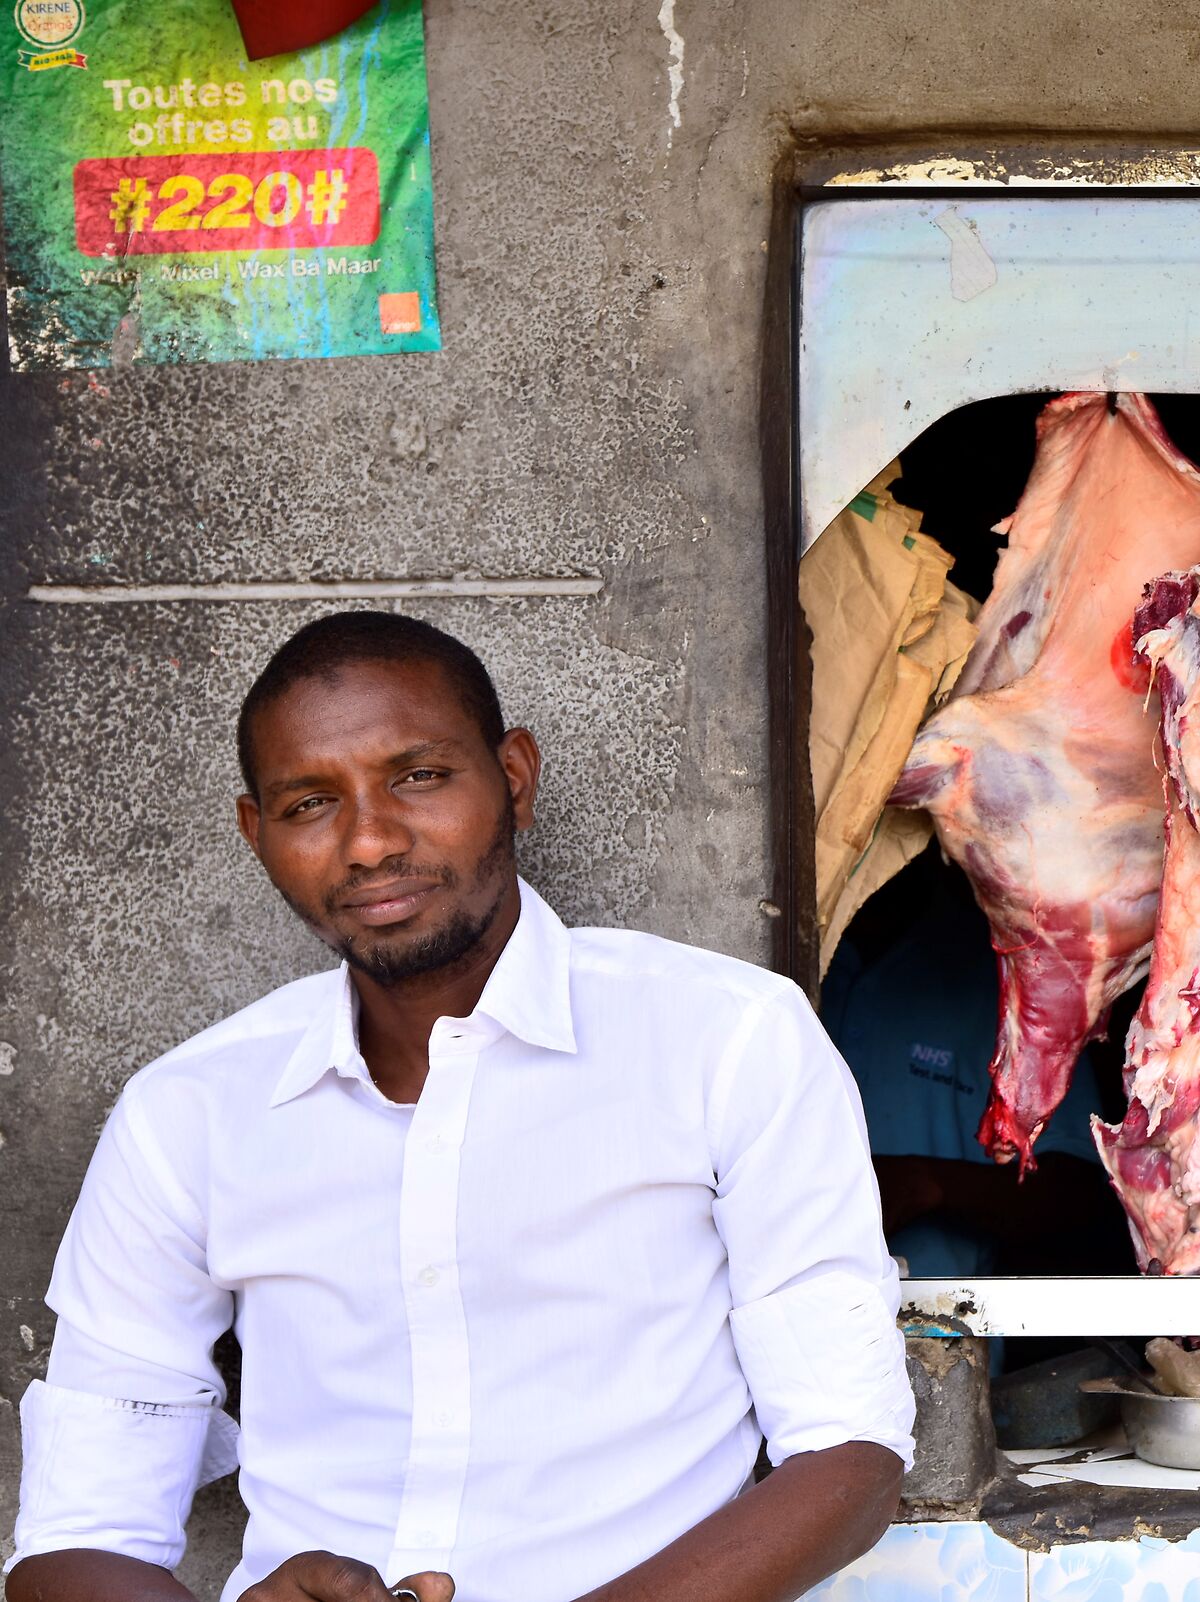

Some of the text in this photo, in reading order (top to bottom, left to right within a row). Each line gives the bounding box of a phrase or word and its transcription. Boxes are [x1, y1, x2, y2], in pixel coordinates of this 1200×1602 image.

[26, 3, 71, 14] KIRENE
[103, 77, 337, 111] Toutes nos
[128, 113, 318, 147] offres au
[109, 169, 349, 233] #220#
[160, 262, 219, 283] Mixel
[238, 259, 285, 280] Wax
[291, 257, 320, 278] Ba
[327, 256, 381, 276] Maar
[911, 1043, 952, 1067] NHS
